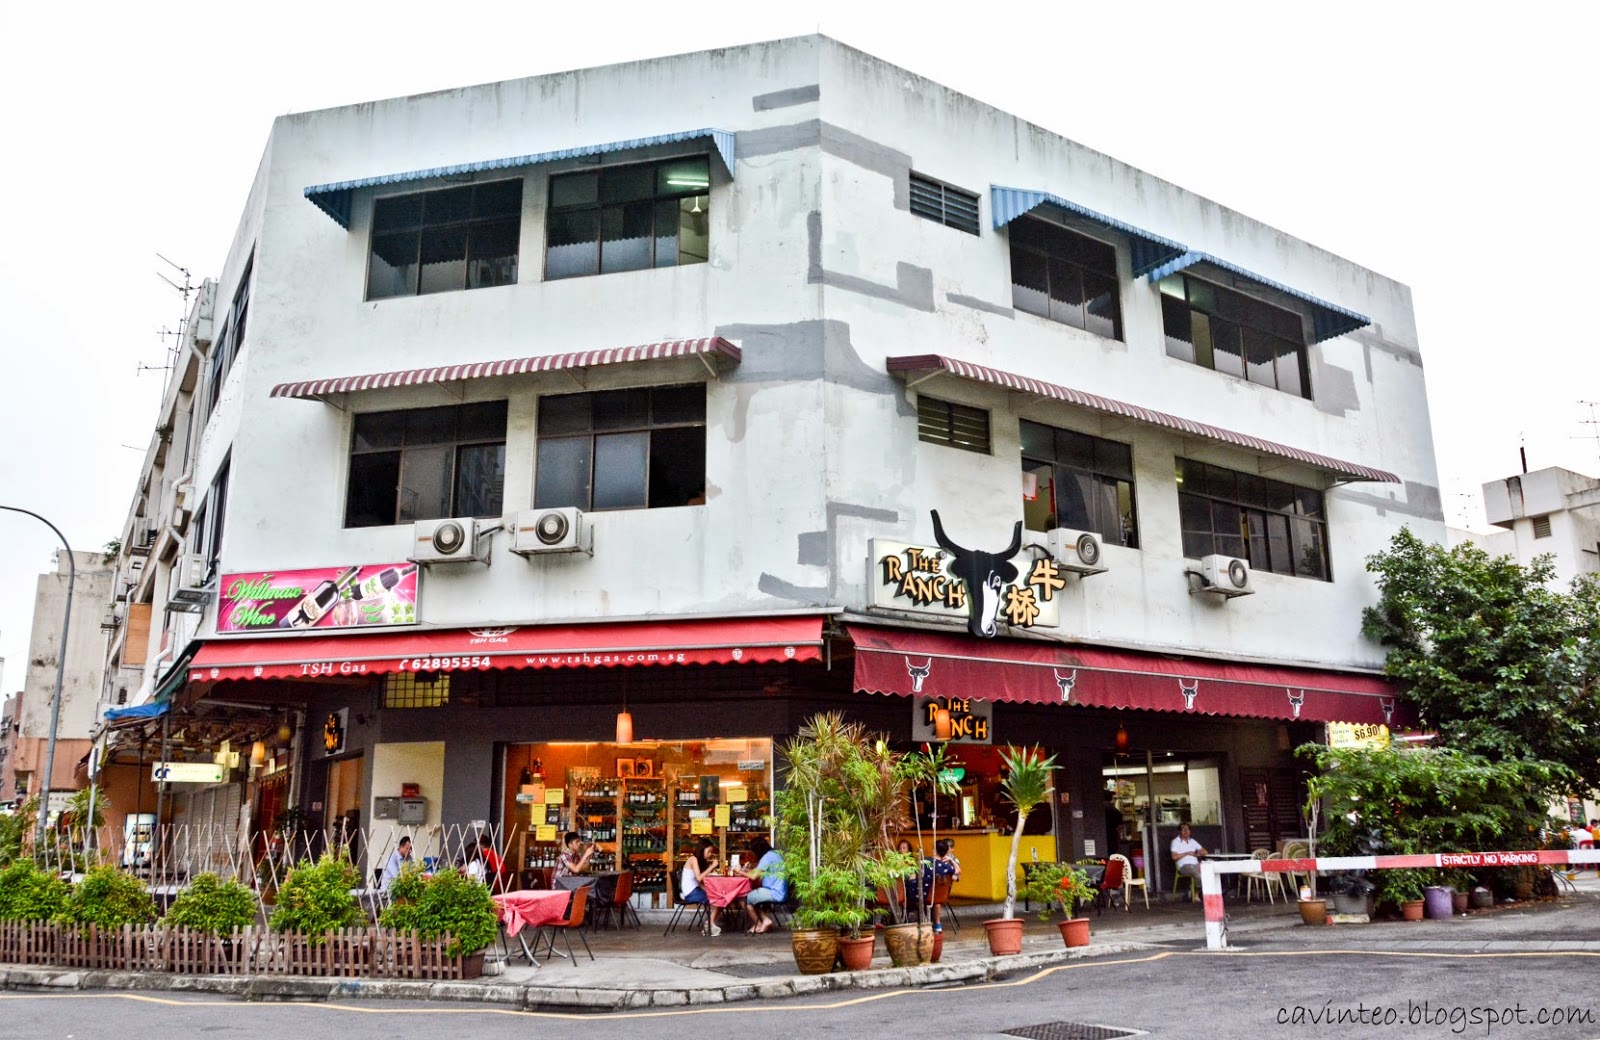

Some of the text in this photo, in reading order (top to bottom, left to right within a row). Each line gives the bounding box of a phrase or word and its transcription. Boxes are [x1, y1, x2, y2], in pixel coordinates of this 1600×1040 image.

[907, 548, 941, 573] THE
[886, 555, 965, 608] RANCH
[231, 602, 276, 627] Wine
[412, 656, 491, 669] 62895554
[526, 651, 685, 665] www.tshgas.com.sg
[300, 662, 366, 675] TSH Gas
[928, 703, 988, 739] RNCH
[1354, 725, 1381, 740] $6.90!
[1442, 853, 1538, 865] STRICTLY NO PARKING
